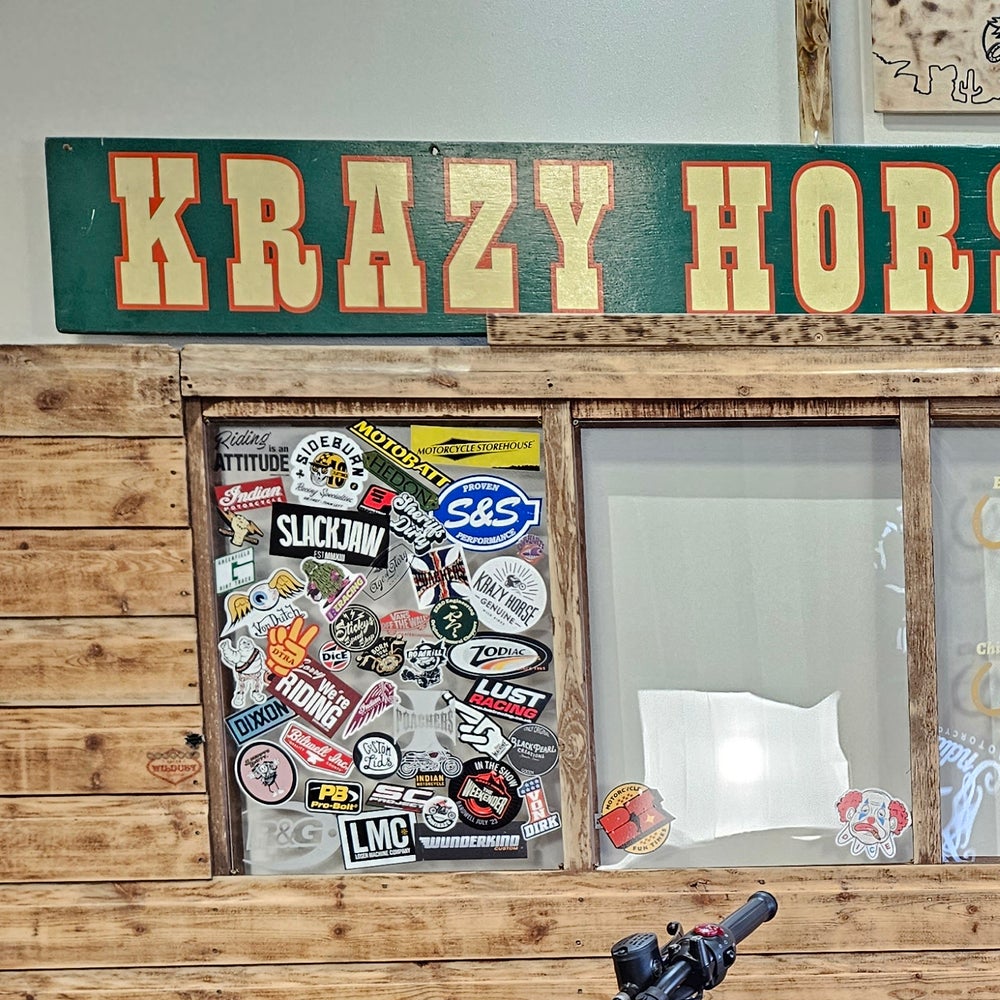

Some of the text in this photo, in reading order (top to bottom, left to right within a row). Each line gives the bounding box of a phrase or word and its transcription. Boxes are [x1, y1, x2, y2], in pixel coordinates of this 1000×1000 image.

[108, 152, 614, 313] KRAZY
[215, 430, 271, 450] Riding
[416, 441, 533, 455] MOTORCYCLE STOREHOUSE
[214, 453, 289, 471] ATTITUDE
[295, 436, 364, 477] SIDEBURN
[353, 420, 452, 488] MOTOBATT
[370, 456, 432, 507] HEDON
[463, 483, 500, 493] PROVEN
[218, 485, 283, 506] Indian
[223, 497, 282, 511] MOTORCYCLE
[444, 496, 521, 528] S&S
[276, 514, 386, 558] SLACKJAW
[391, 514, 431, 551] Dirty
[456, 528, 516, 545] PERFORMANCE
[473, 571, 507, 605] KRAZY
[504, 593, 539, 627] HORSE
[480, 597, 516, 626] GENUINE
[272, 648, 296, 666] DTRA
[470, 645, 526, 667] ZODIAC
[274, 673, 343, 730] RIDING
[469, 693, 538, 719] RACING
[475, 679, 546, 707] LUST
[234, 700, 290, 737] DIXXON
[287, 727, 328, 758] Biltwell
[364, 754, 393, 771] Lids
[475, 761, 484, 771] IN
[485, 761, 500, 773] THE
[499, 765, 519, 788] SHOW
[416, 774, 444, 782] INDIAN
[319, 784, 349, 801] PB
[372, 784, 434, 805] SC
[462, 779, 509, 816] WEEKENDER
[605, 786, 641, 810] MOTORCYCLE
[526, 793, 546, 821] VON
[350, 817, 409, 853] LMC
[524, 815, 560, 839] DIRK
[649, 827, 667, 850] TIMES
[419, 835, 520, 849] WUNDERKIND
